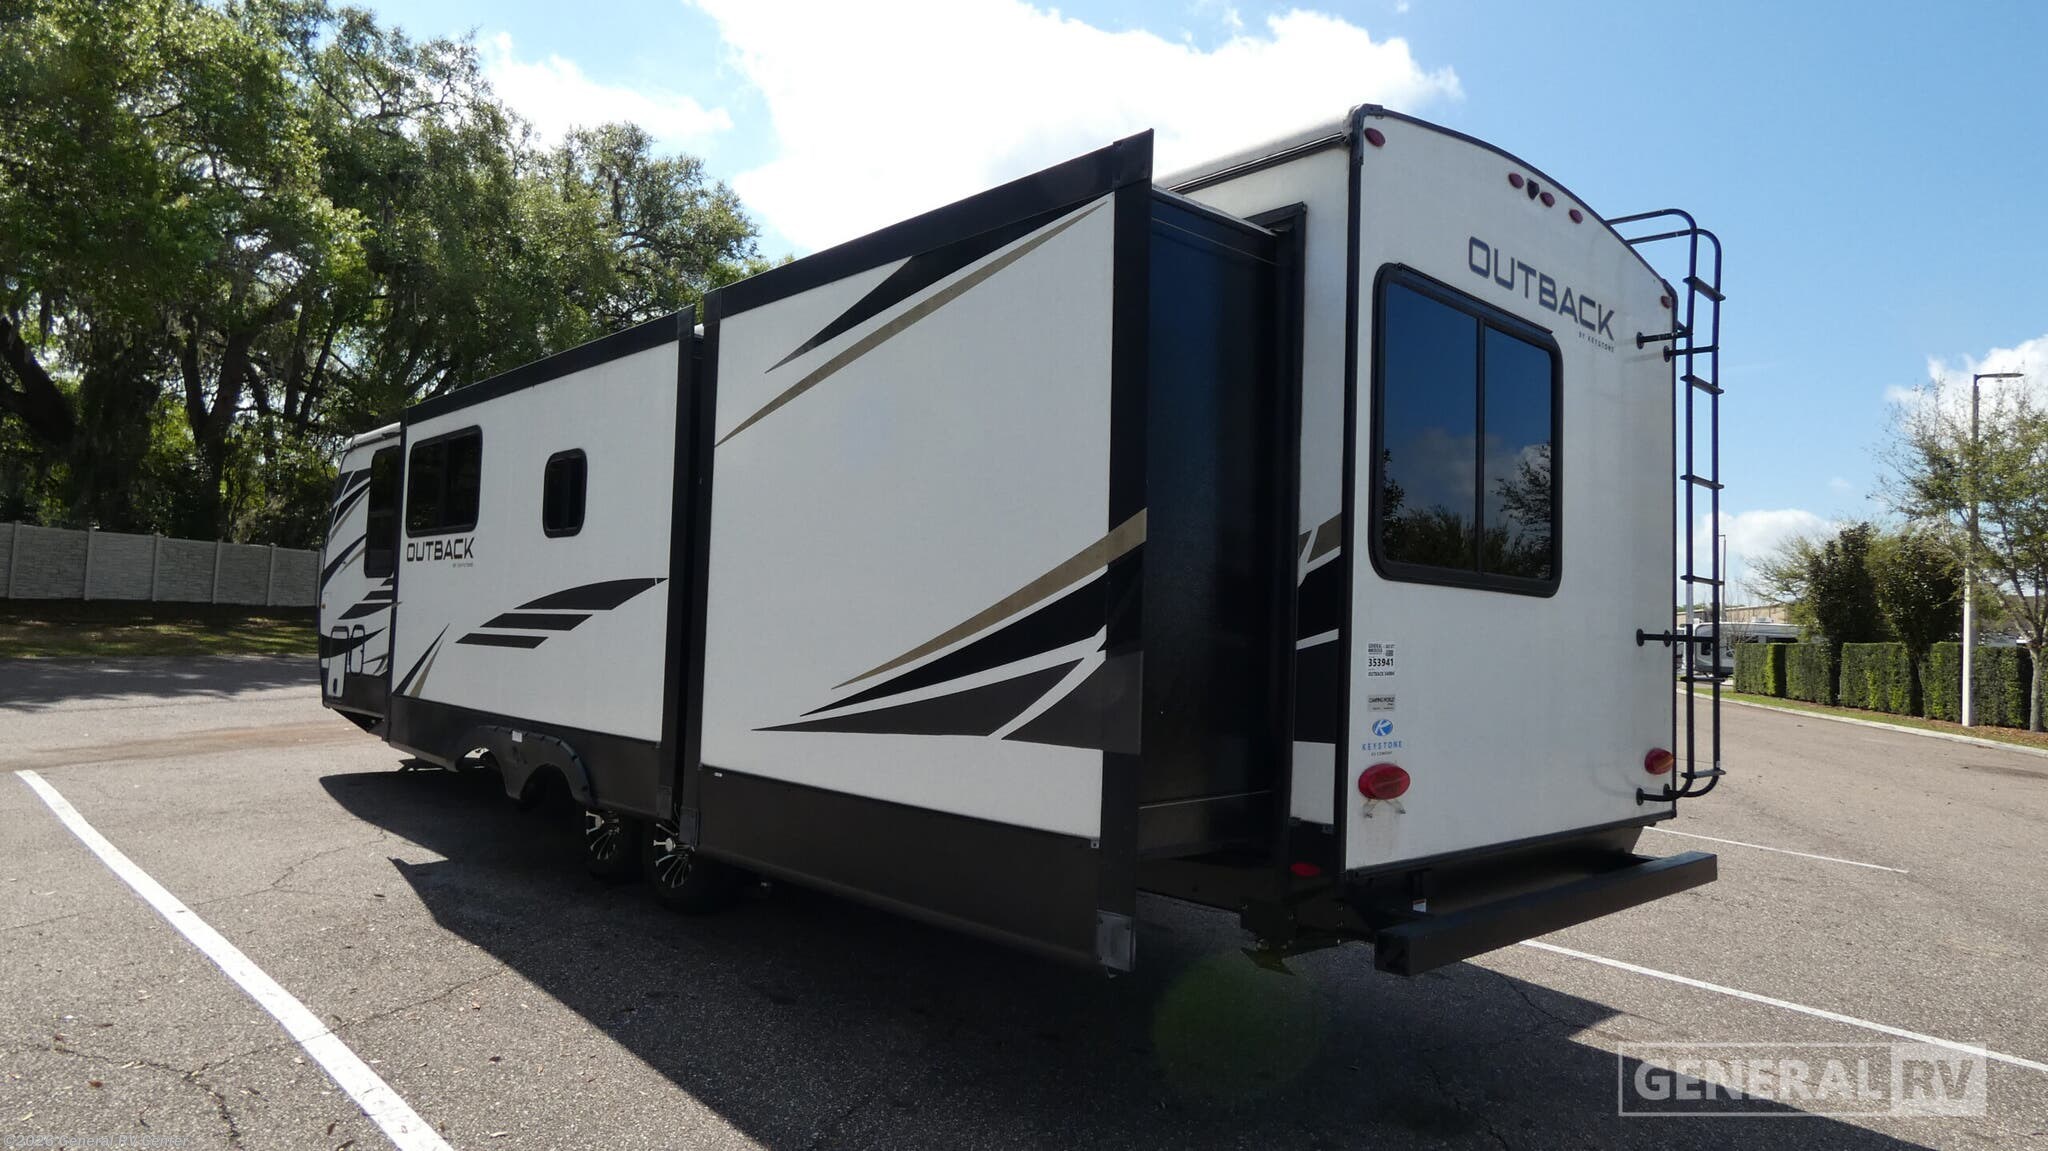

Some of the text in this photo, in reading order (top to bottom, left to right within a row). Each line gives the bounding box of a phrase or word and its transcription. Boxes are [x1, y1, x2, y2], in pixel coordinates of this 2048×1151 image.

[1469, 236, 1615, 341] OUTBACK
[1587, 336, 1614, 352] KEYSTONE
[406, 537, 475, 562] OUTBACK
[1368, 658, 1394, 667] 353941
[1361, 741, 1402, 750] KEYSTONE
